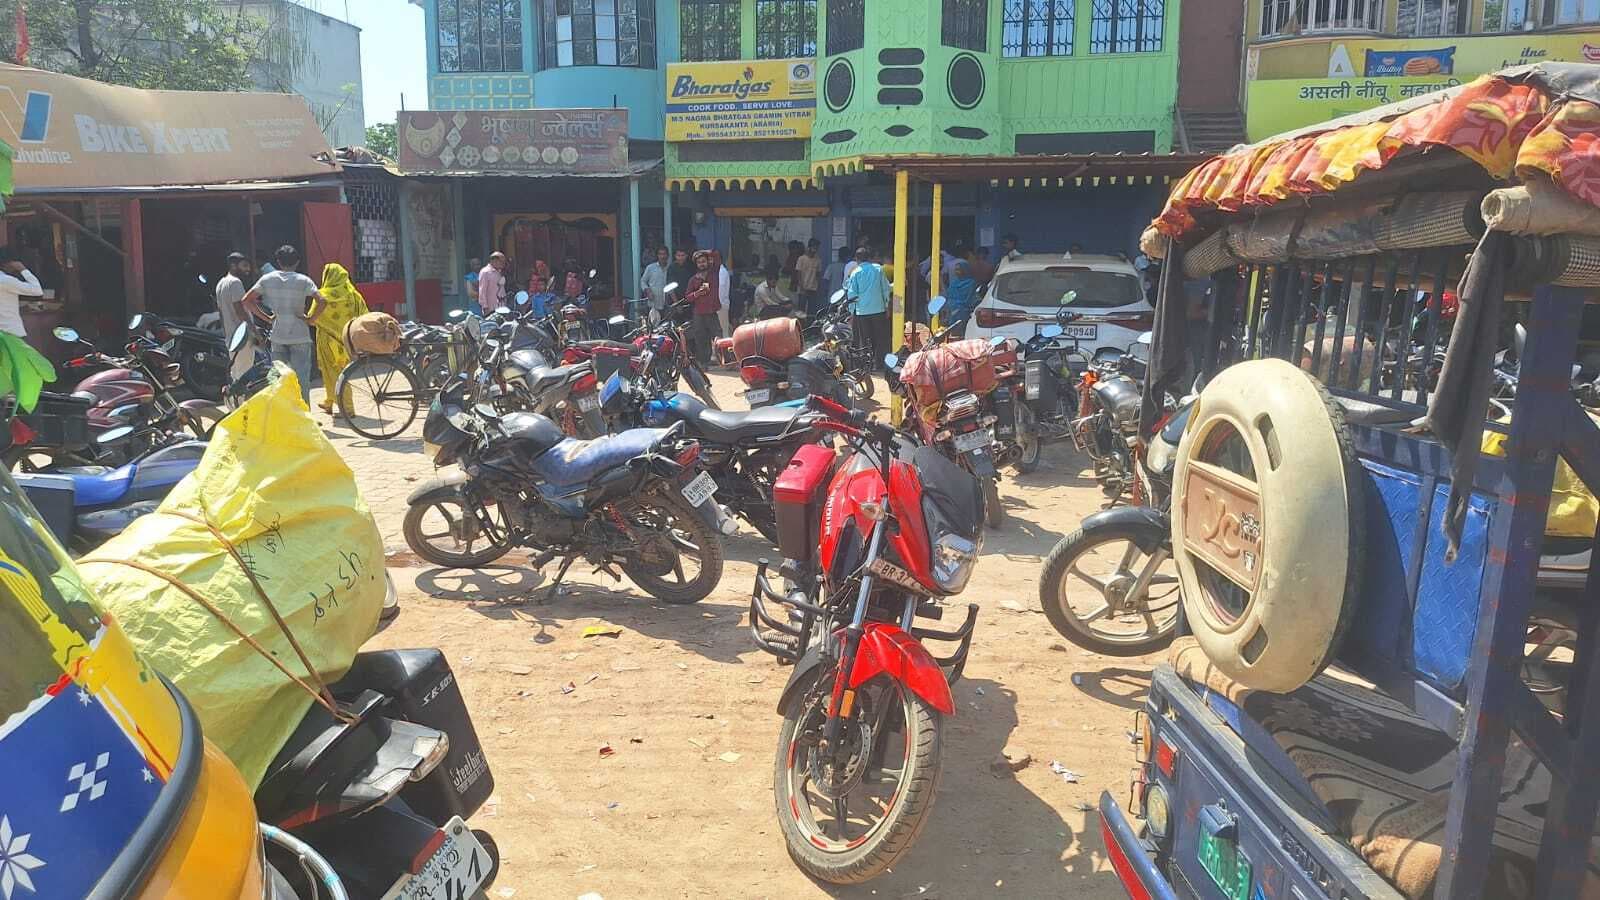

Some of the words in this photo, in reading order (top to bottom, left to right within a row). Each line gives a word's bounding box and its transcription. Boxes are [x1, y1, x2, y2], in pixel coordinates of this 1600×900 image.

[672, 74, 772, 99] Bharatgas
[1299, 80, 1352, 99] असली
[1355, 80, 1389, 103] नींबू
[685, 114, 711, 122] NAGMA
[752, 112, 782, 120] GRAMIN
[688, 104, 711, 112] COOK
[742, 102, 769, 110] SERVE
[74, 113, 148, 155] BIKE
[15, 147, 73, 165] alvoline
[449, 750, 485, 787] Steelbir
